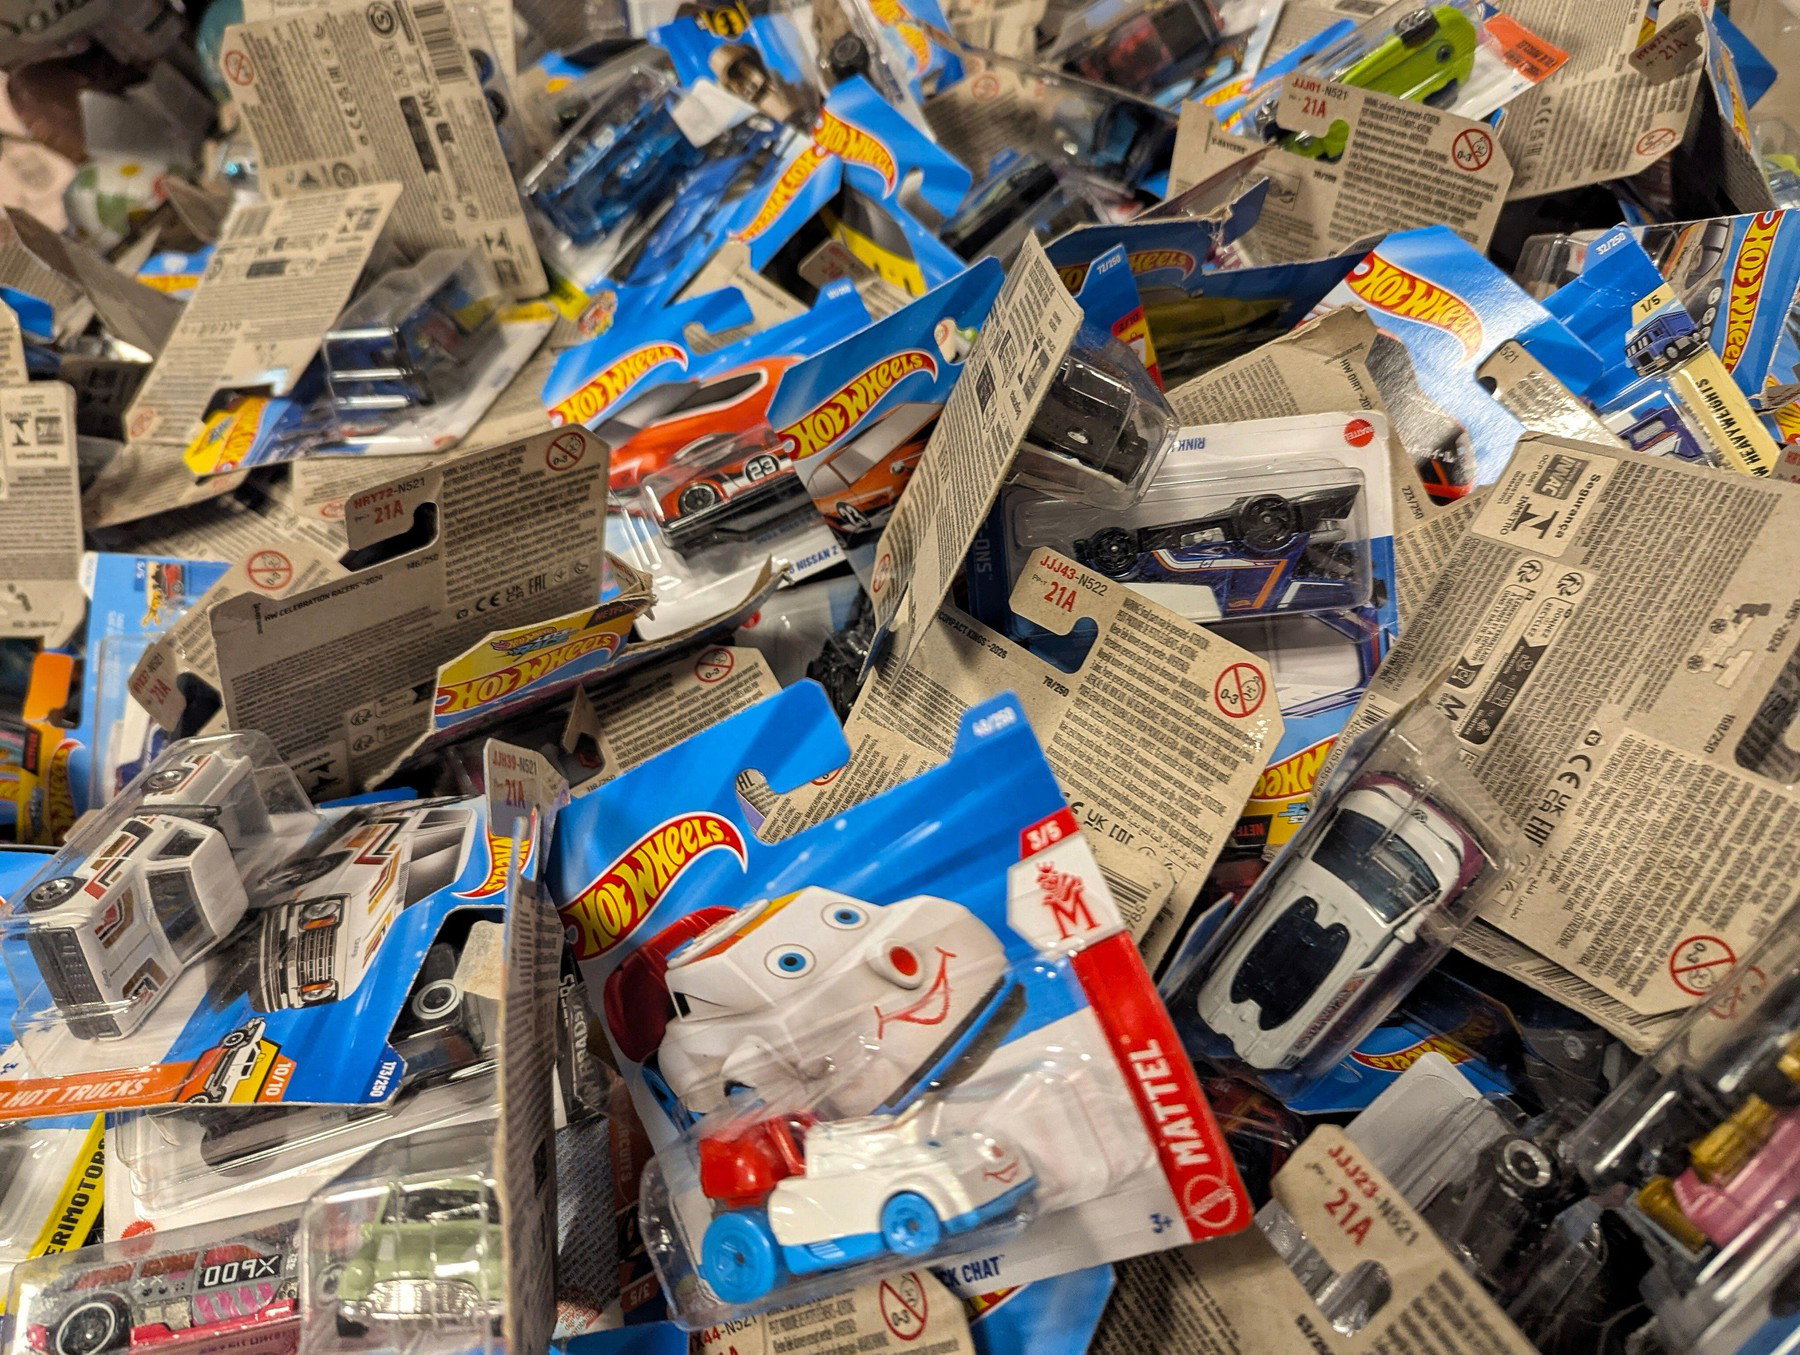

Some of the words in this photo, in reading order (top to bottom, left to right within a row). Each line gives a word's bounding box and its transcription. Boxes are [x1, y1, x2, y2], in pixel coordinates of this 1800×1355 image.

[1301, 97, 1328, 118] 21A
[1596, 232, 1627, 256] 32/250
[1129, 250, 1187, 273] HEELS
[1640, 294, 1661, 313] 1/5
[748, 456, 777, 479] 23
[374, 500, 405, 526] 21A
[1499, 494, 1531, 537] INMETRO
[1553, 472, 1603, 540] Segurança
[1040, 555, 1109, 598] JJJ43-N522
[1043, 580, 1078, 614] 21A
[936, 611, 968, 634] COMPACT
[1219, 687, 1240, 706] 0-3
[1027, 821, 1063, 851] 3/5
[8, 1087, 59, 1109] HOT
[60, 1076, 152, 1105] TRUCKS
[265, 1062, 293, 1097] 10/10
[369, 1060, 398, 1099] 173/250
[1128, 1038, 1211, 1168] MATTEL
[1327, 1144, 1419, 1247] JJJ23-N521
[1323, 1188, 1375, 1246] 21A
